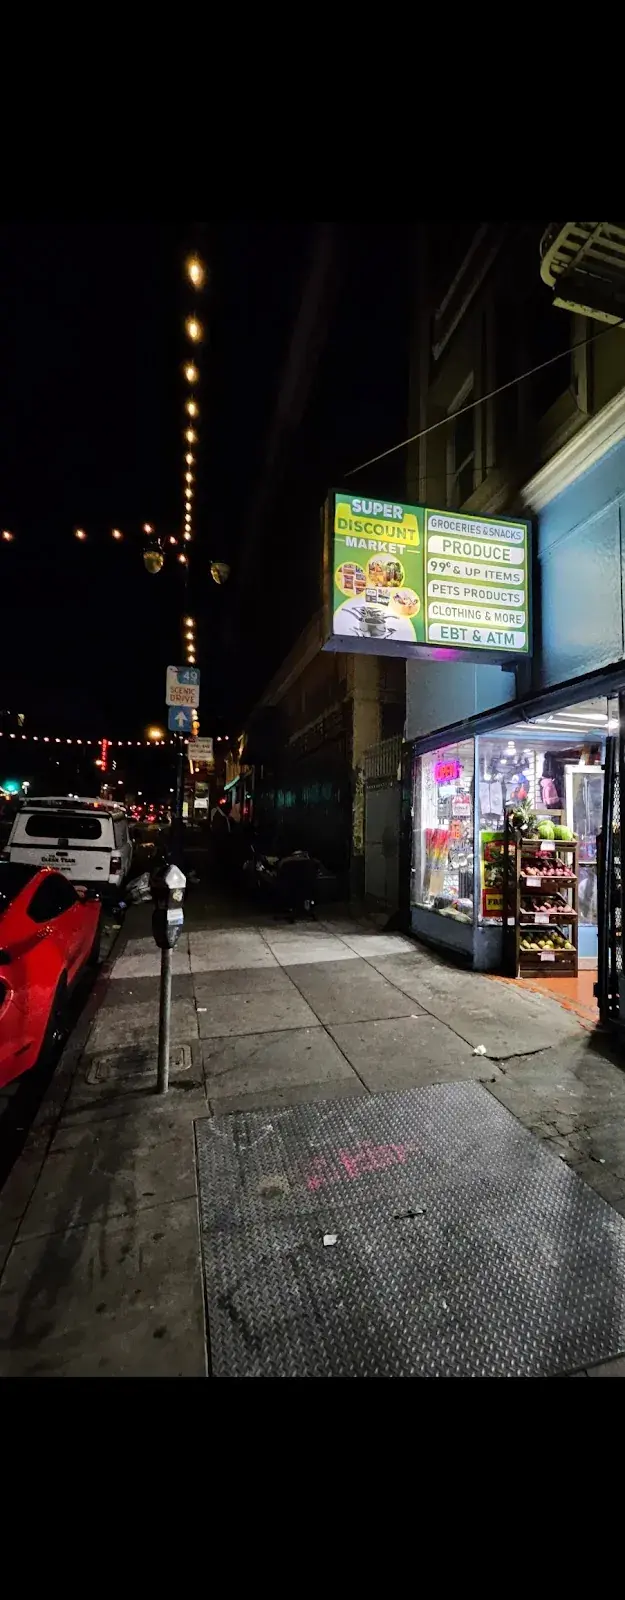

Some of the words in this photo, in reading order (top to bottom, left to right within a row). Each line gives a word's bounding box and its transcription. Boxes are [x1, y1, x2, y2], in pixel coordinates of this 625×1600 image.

[352, 499, 404, 519] SUPER
[338, 518, 416, 540] DISCOUNT
[431, 518, 482, 534] GROCERIES
[345, 536, 406, 554] MARKET
[442, 539, 510, 561] PRODUCE
[452, 566, 460, 574] &
[465, 567, 480, 576] UP
[485, 570, 520, 582] ITEMS
[432, 584, 460, 596] PETS
[464, 588, 520, 602] PRODUCTS
[432, 606, 482, 620] CLOTHING
[484, 612, 492, 620] &
[494, 612, 522, 624] MORE
[440, 626, 468, 640] EBT
[472, 630, 482, 642] &
[486, 632, 514, 646] ATM
[183, 671, 198, 682] 49
[170, 686, 196, 695] SCENIC
[170, 694, 195, 703] DRIVE
